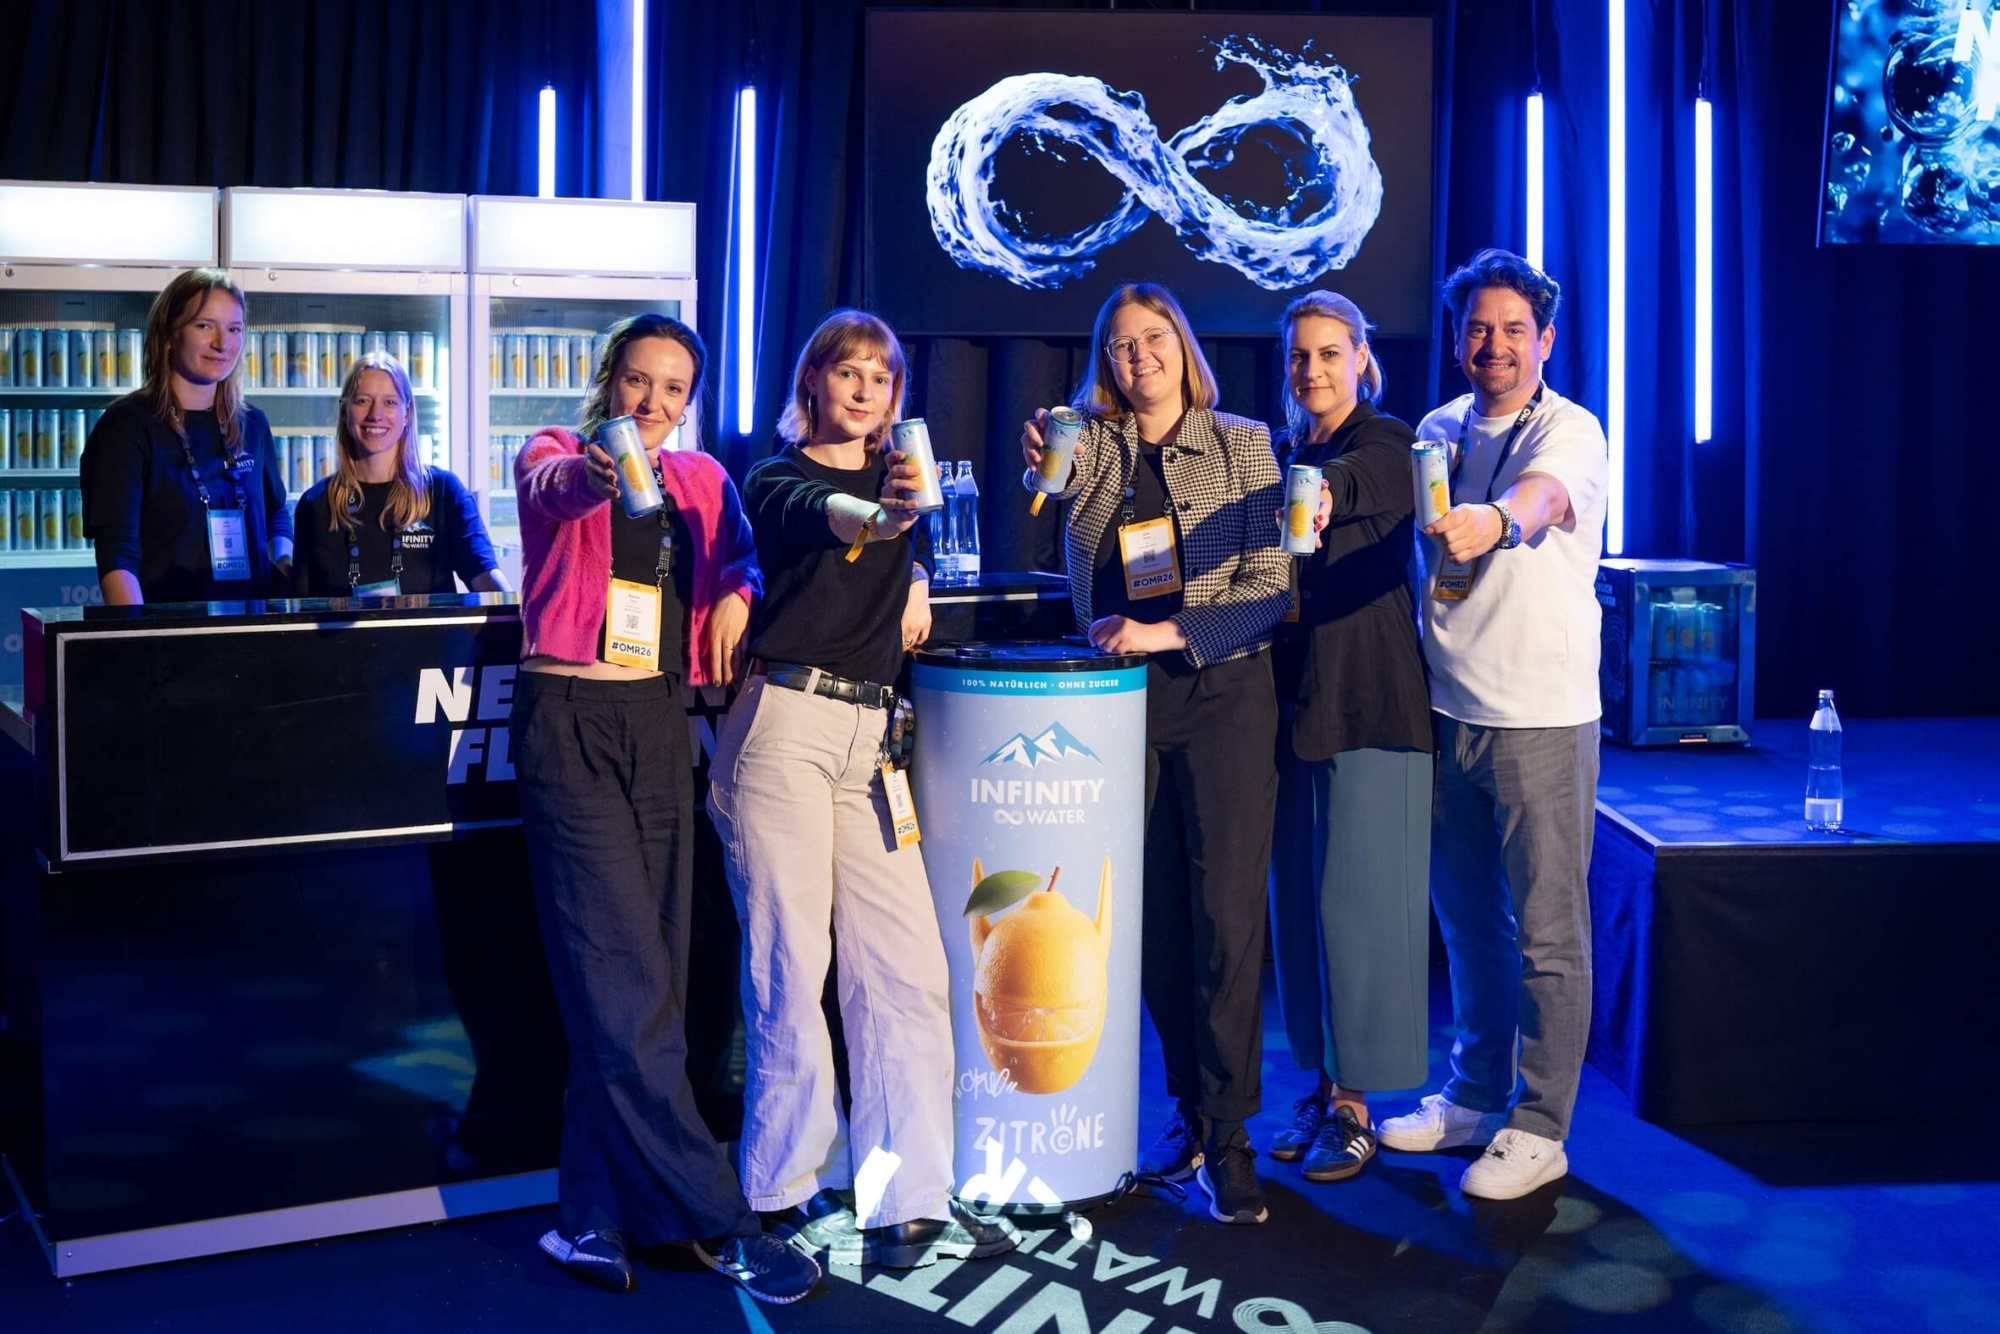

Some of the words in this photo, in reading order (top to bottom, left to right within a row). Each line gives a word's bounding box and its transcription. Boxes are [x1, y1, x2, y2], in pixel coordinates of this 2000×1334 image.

[1133, 572, 1174, 588] #OMR26
[611, 641, 652, 657] #OMR26
[962, 679, 986, 687] 100%
[989, 679, 1047, 689] NATÜRLICH
[1058, 680, 1085, 689] OHNE
[1088, 679, 1119, 688] ZUCKER
[970, 778, 1105, 806] INFINITY
[1026, 809, 1085, 825] WATER
[972, 1110, 1105, 1154] ZITRONE
